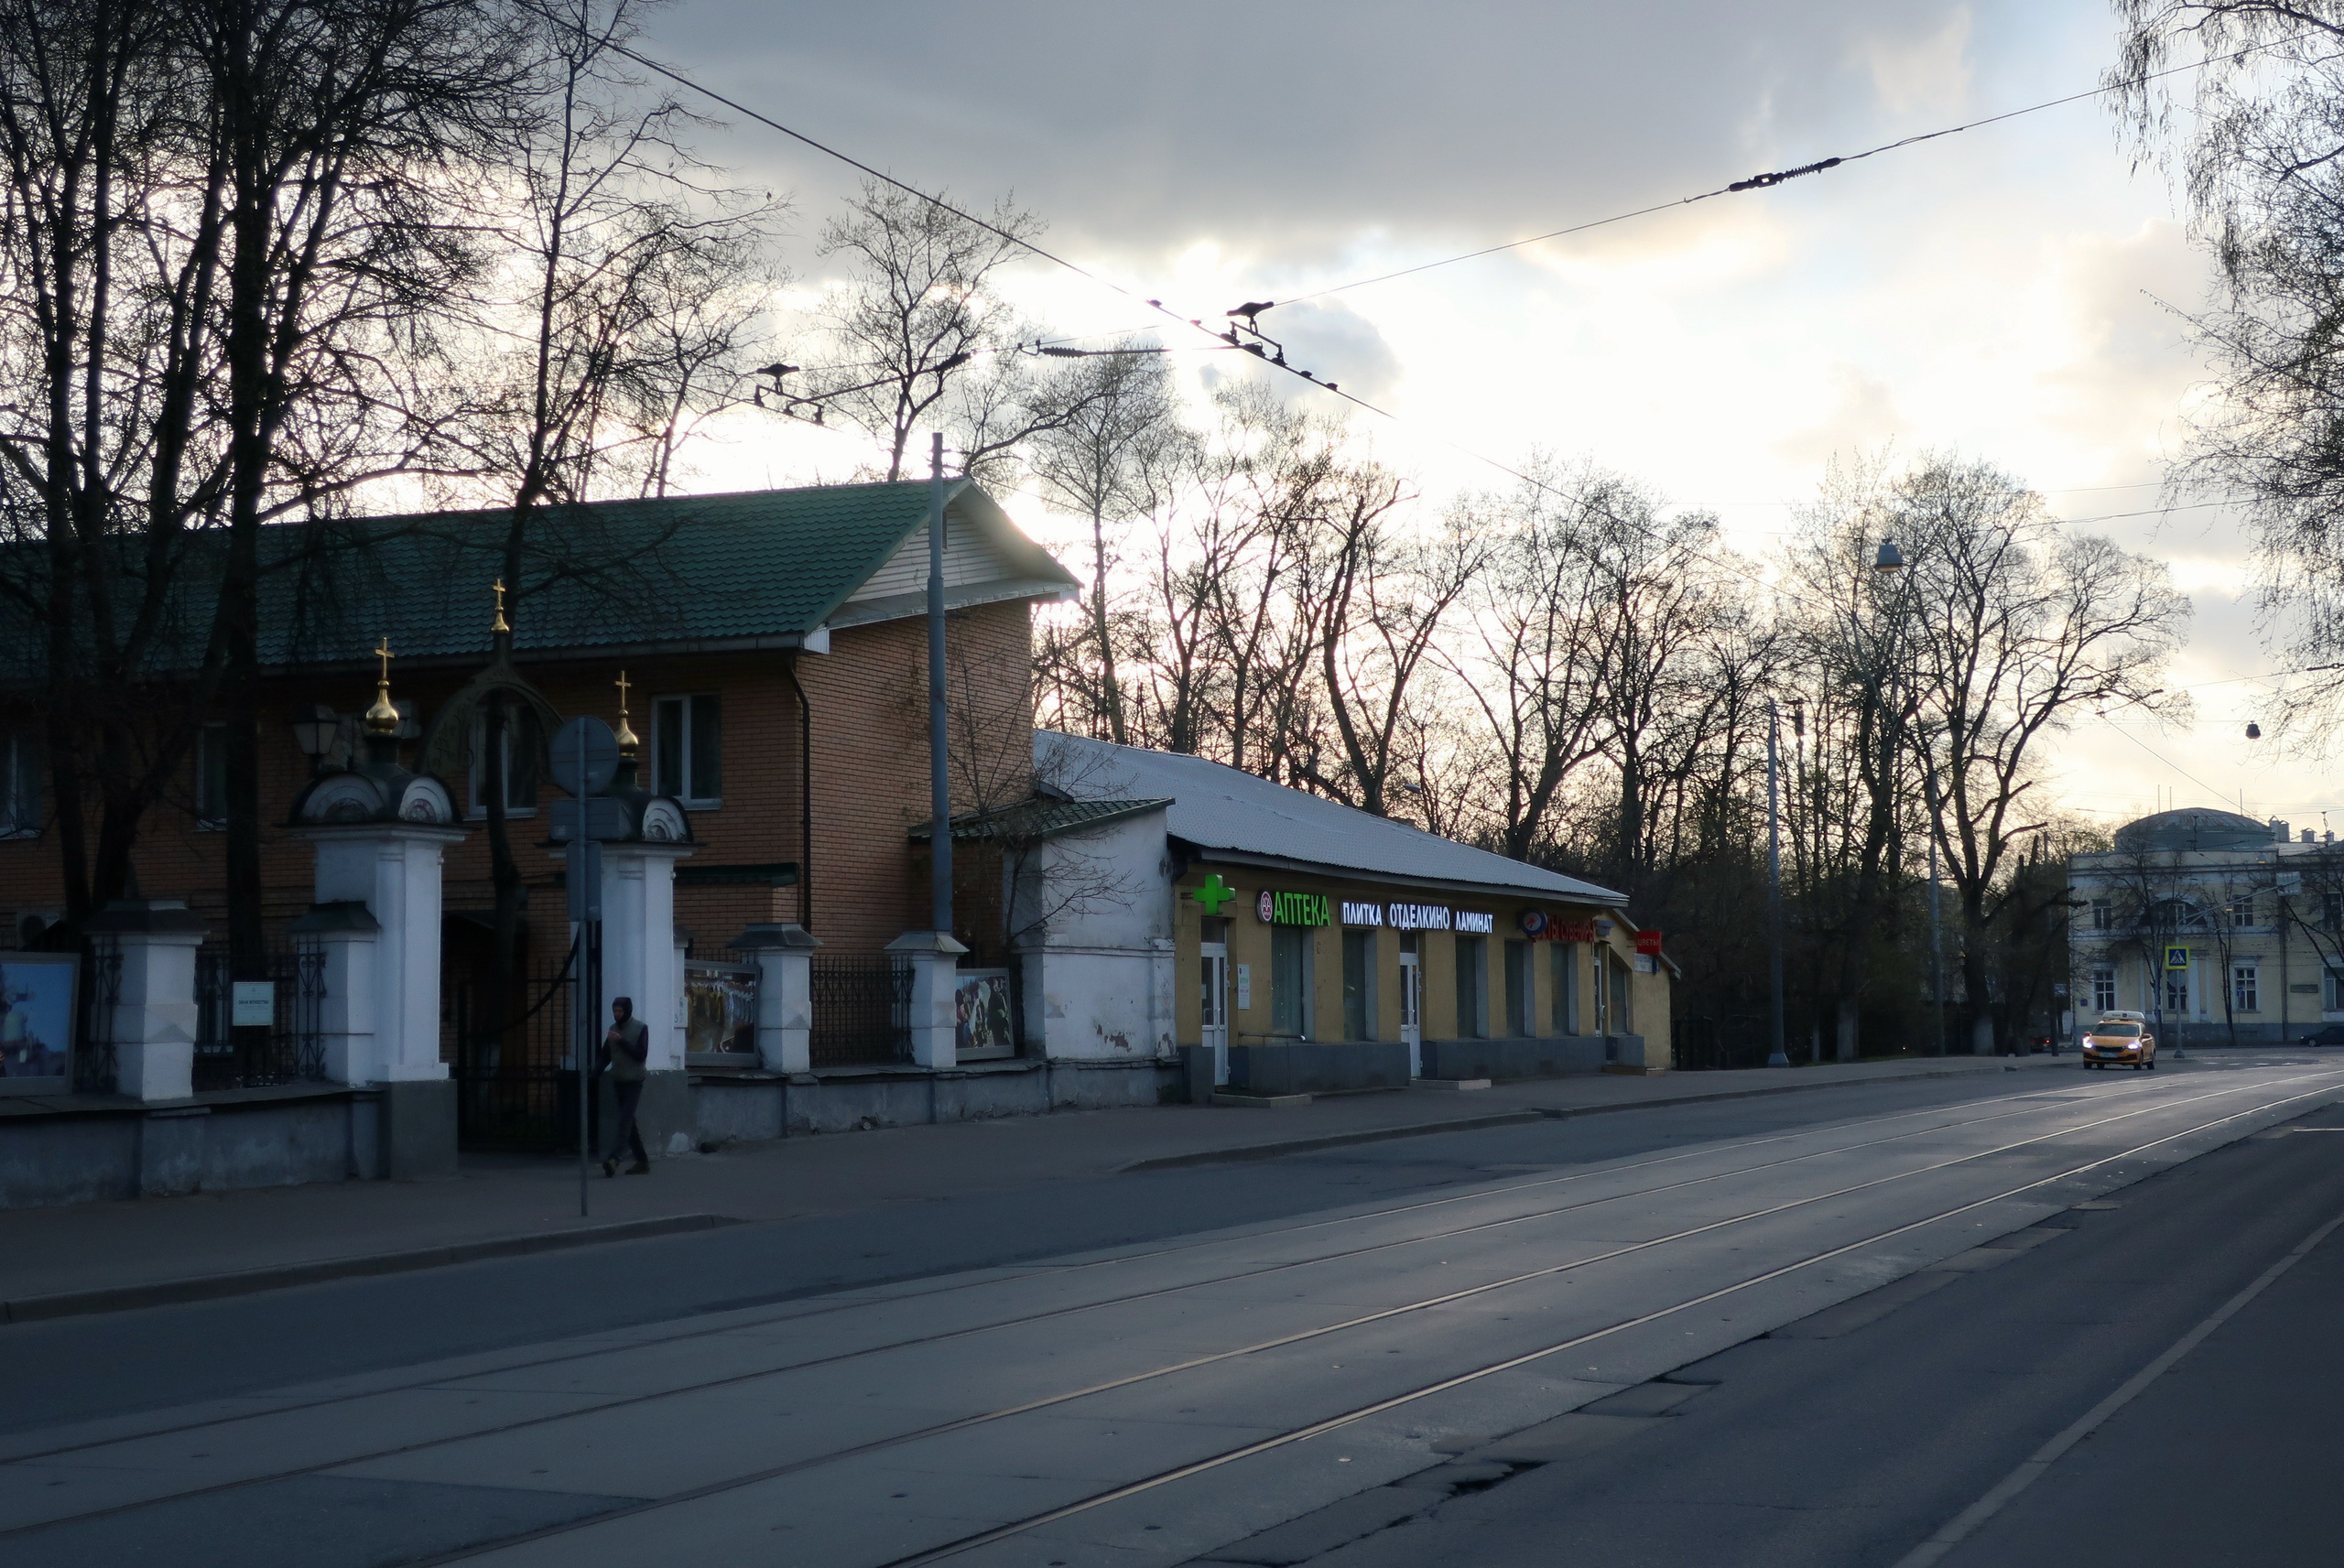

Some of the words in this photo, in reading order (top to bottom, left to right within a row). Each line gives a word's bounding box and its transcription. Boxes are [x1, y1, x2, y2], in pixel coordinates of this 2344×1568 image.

[1274, 891, 1330, 926] АПТЕКА
[1342, 902, 1383, 926] ПЛИТКА
[1389, 903, 1450, 930] ОТДЕЛКИНО
[1455, 911, 1493, 934] ЛАМИНАТ
[1637, 938, 1659, 946] ЦВЕТЫ
